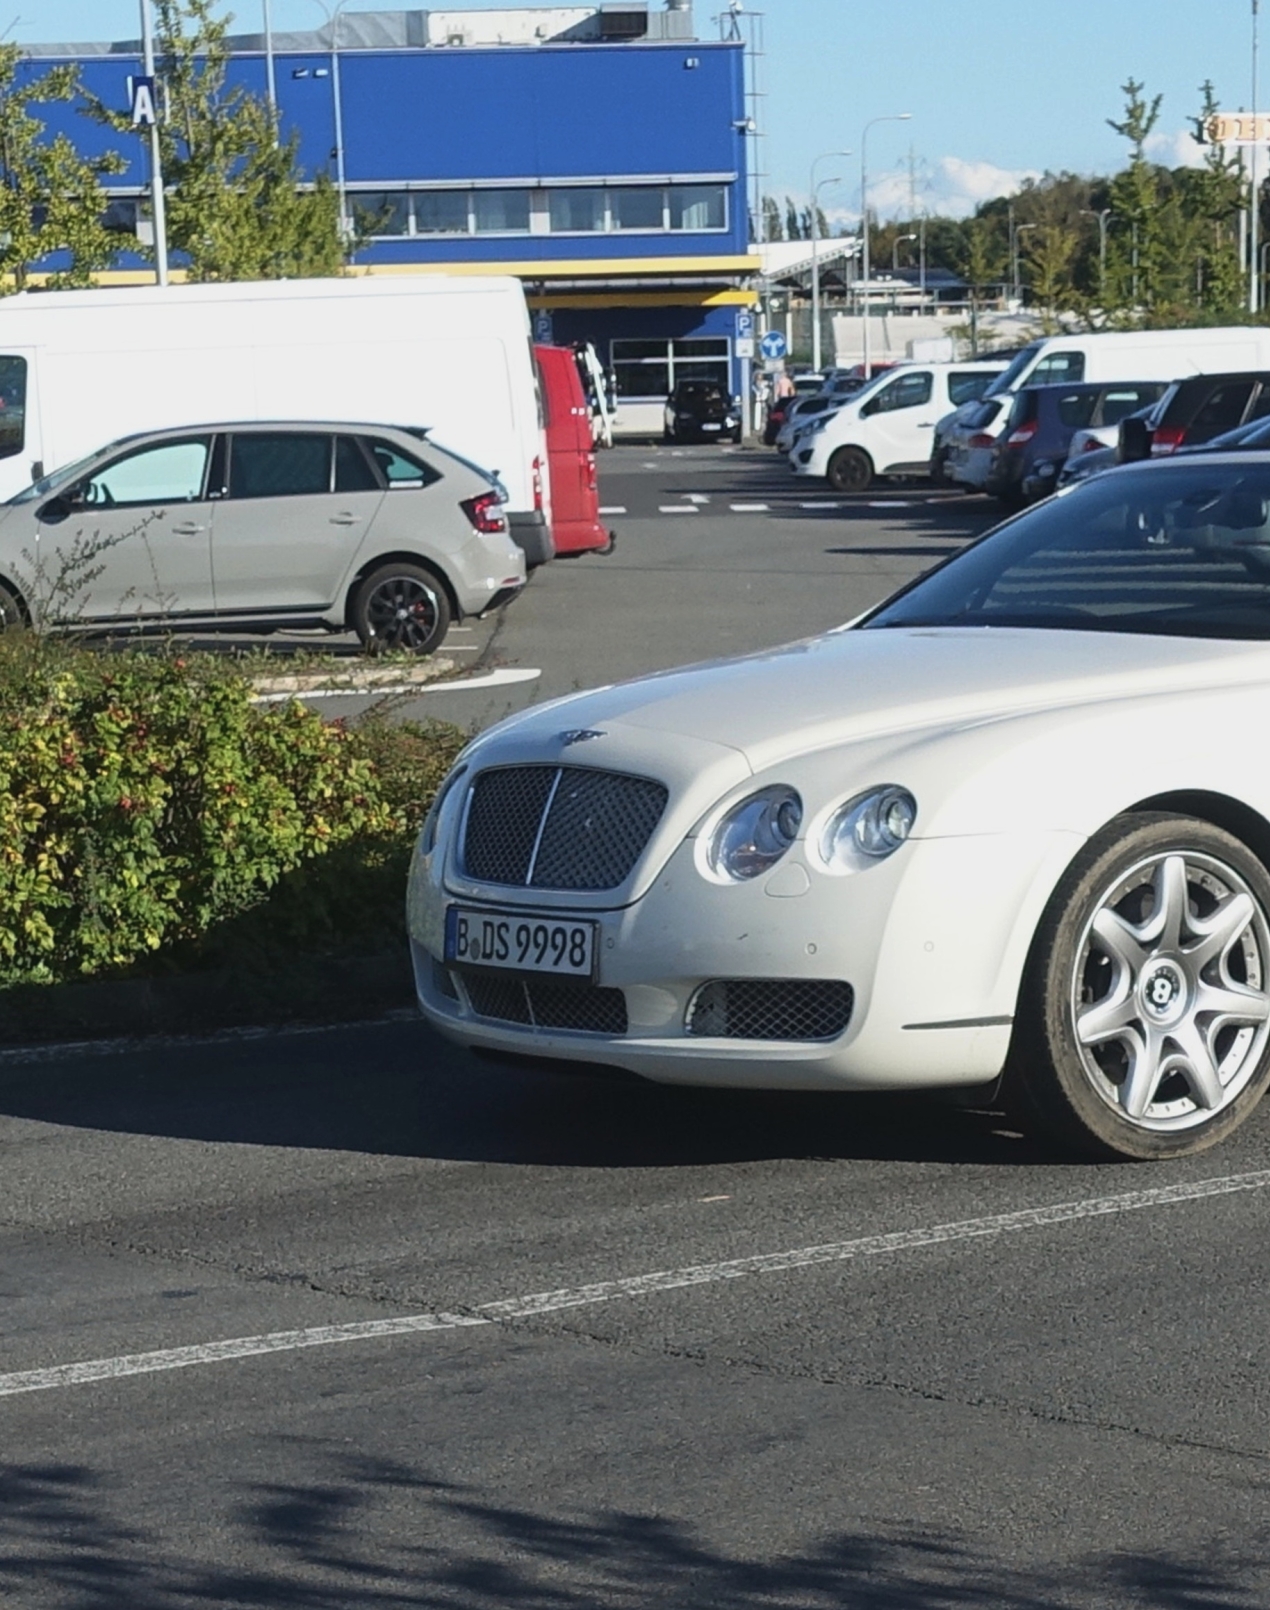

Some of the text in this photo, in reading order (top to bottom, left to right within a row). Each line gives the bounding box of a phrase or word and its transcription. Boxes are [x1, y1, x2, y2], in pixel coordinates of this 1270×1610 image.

[133, 85, 156, 124] A
[537, 320, 548, 333] P
[739, 316, 750, 331] P
[458, 918, 586, 967] B DS 9998
